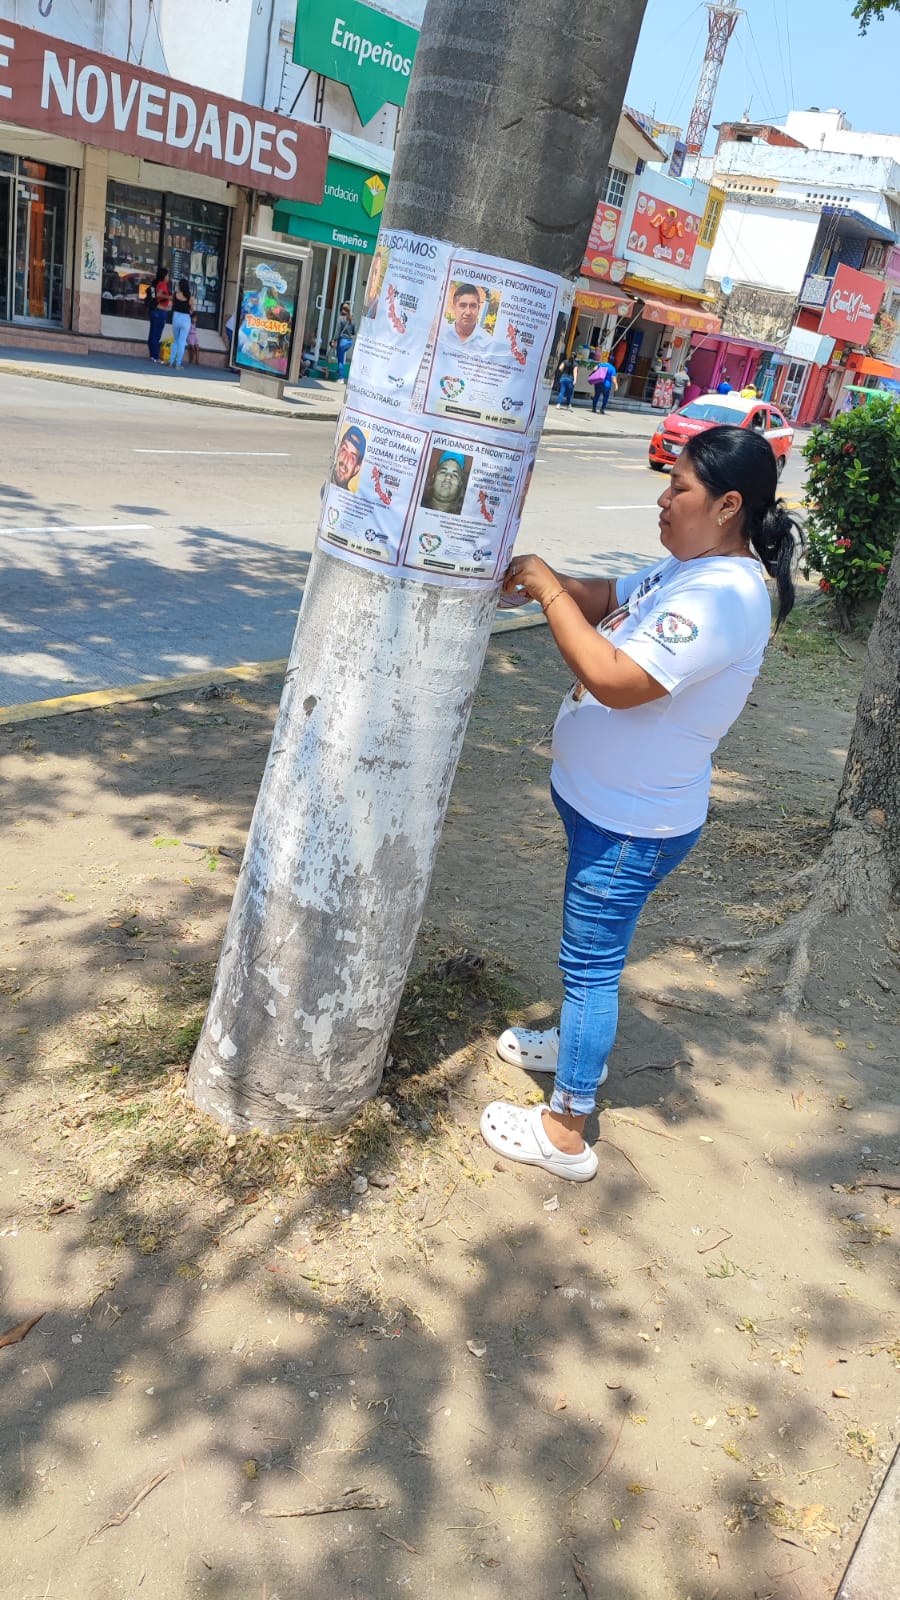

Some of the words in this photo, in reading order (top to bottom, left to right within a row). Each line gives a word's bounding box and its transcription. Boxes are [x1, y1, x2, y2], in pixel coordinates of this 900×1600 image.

[331, 18, 412, 77] Empeños
[41, 49, 298, 181] NOVEDADES
[324, 184, 359, 204] undación
[332, 228, 368, 249] Empeños
